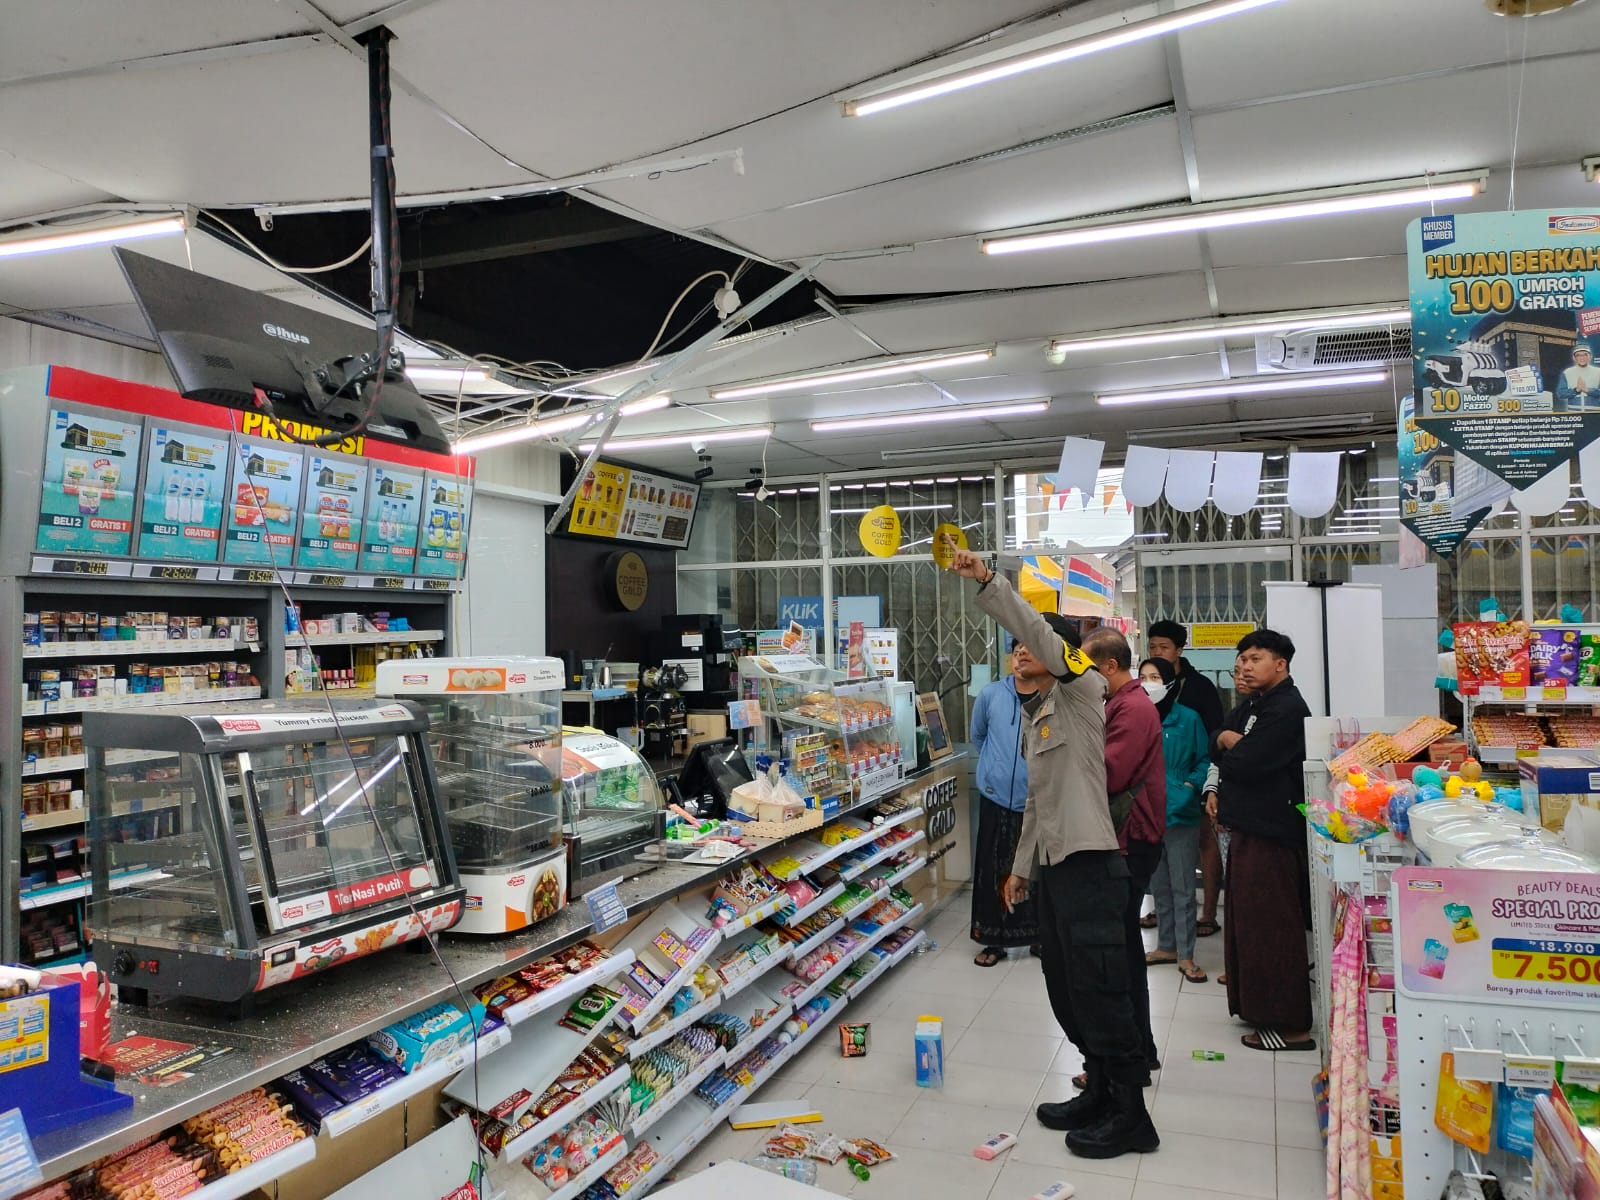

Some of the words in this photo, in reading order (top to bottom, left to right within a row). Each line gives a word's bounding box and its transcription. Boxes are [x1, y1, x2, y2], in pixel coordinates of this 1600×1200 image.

[1423, 220, 1452, 231] KHUSUS
[1423, 231, 1453, 241] MEMBER
[1426, 252, 1506, 279] HUJAN
[1510, 247, 1600, 275] BERKAH
[1450, 279, 1514, 314] 100
[1518, 277, 1585, 293] UMROH
[1519, 294, 1585, 310] GRATIS
[1431, 389, 1460, 412] 10
[1497, 399, 1520, 412] 300
[1463, 402, 1492, 410] Fazzio
[53, 516, 74, 526] BELI
[75, 518, 81, 527] 2
[91, 518, 120, 530] GRATIS
[121, 521, 126, 531] 1
[153, 525, 171, 534] BELI
[172, 526, 177, 535] 2
[184, 527, 210, 538] GRATIS
[237, 532, 252, 541] BELI
[252, 533, 258, 542] 2
[310, 540, 323, 548] BELI
[619, 575, 646, 586] COFFEE
[1530, 644, 1560, 655] DAIRY
[1530, 652, 1553, 660] MILK
[274, 717, 310, 727] Yummy
[310, 716, 333, 725] Fried
[336, 713, 369, 723] Chicken
[922, 776, 958, 812] COFFEE
[929, 807, 957, 841] GOLD
[351, 885, 375, 902] Nasi
[376, 878, 403, 895] Putih
[1517, 882, 1561, 896] BEAUTY
[1492, 898, 1565, 919] SPECIAL
[1540, 941, 1595, 954] 18.900
[1499, 952, 1511, 960] Rp
[1515, 986, 1542, 995] produk
[1545, 987, 1584, 997] favoritmu
[582, 999, 603, 1009] MILO
